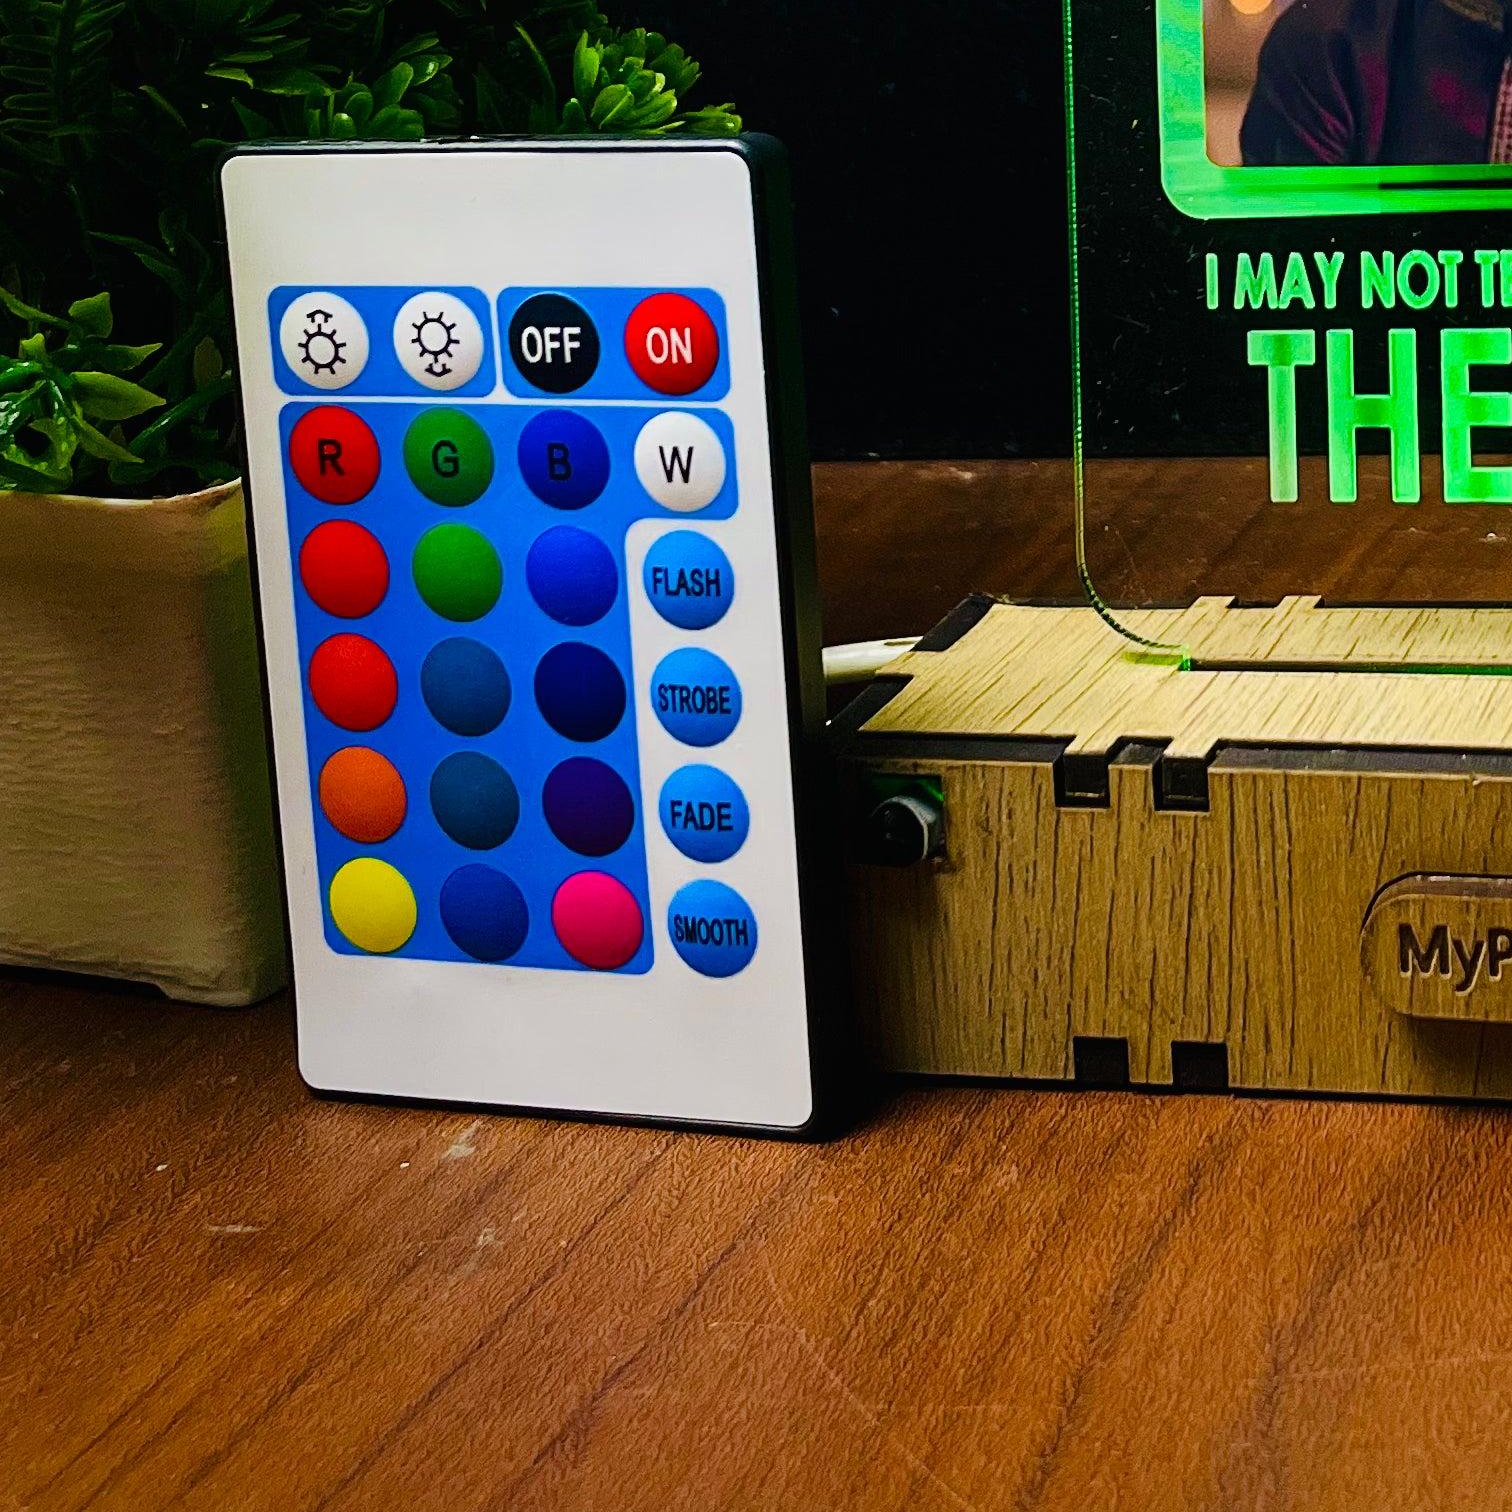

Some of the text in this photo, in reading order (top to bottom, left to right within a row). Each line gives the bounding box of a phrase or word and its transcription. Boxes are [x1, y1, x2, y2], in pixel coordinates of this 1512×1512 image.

[1205, 253, 1219, 309] I
[1233, 253, 1344, 308] MAY
[1360, 250, 1463, 309] NOT
[520, 326, 694, 365] OFF ON
[317, 440, 694, 485] R G B W
[652, 565, 721, 600] FLASH
[657, 683, 732, 718] STROBE
[670, 798, 732, 833] FADE
[673, 912, 750, 948] SMOOTH
